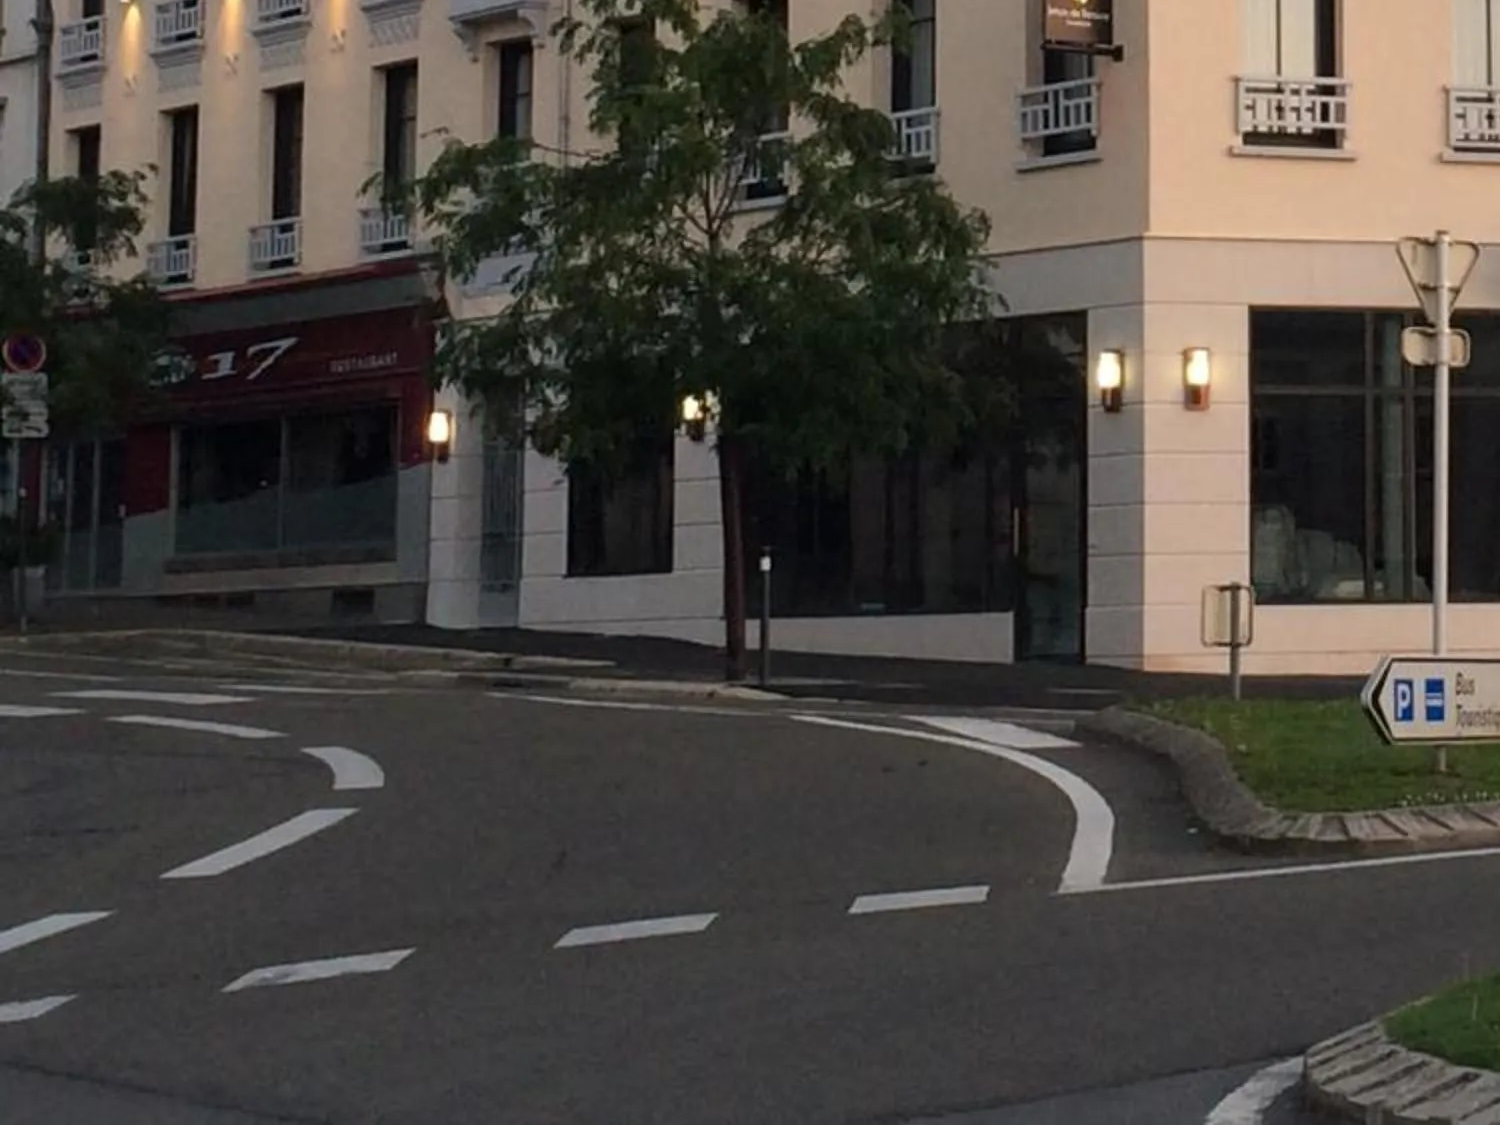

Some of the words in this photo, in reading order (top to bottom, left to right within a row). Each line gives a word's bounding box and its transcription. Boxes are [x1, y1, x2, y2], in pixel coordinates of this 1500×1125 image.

[330, 352, 397, 373] RESTAURANT
[1456, 672, 1475, 695] Bus
[1397, 682, 1412, 718] P
